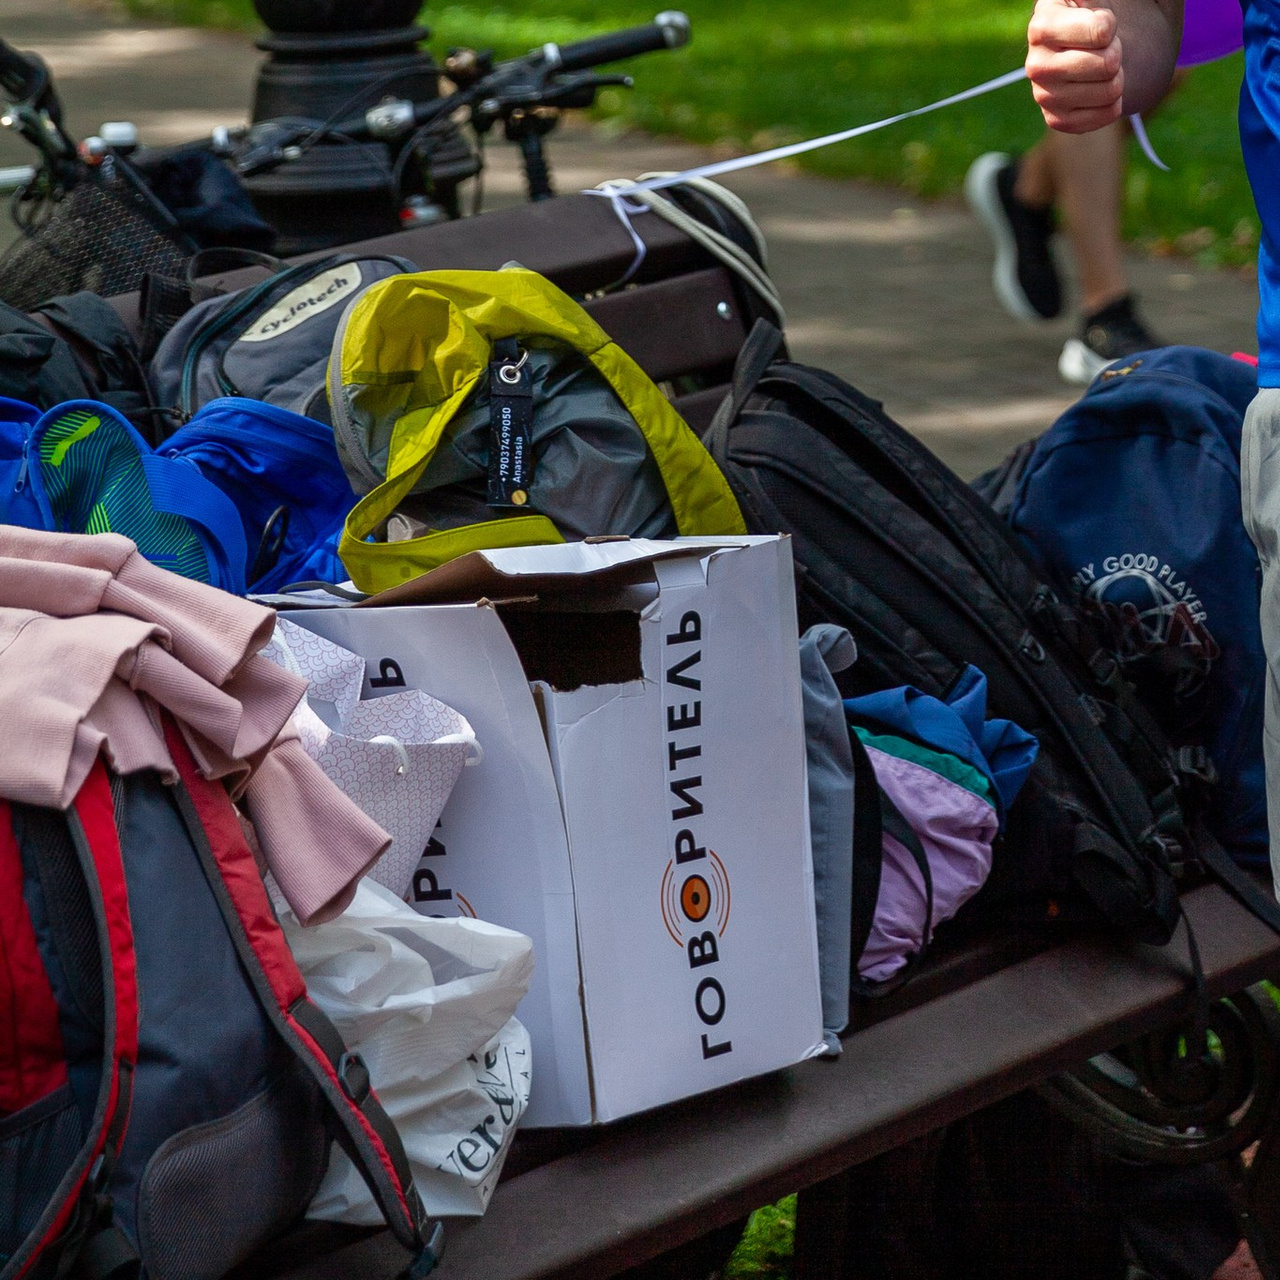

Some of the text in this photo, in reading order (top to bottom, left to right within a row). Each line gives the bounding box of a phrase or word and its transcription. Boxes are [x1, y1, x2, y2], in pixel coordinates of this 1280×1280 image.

[499, 407, 512, 483] +79037499050
[512, 436, 524, 484] Anastasia
[1103, 553, 1159, 573] GOOD
[1158, 564, 1208, 624] PLAYER
[666, 609, 733, 1061] ГОВОРИТЕЛЬ
